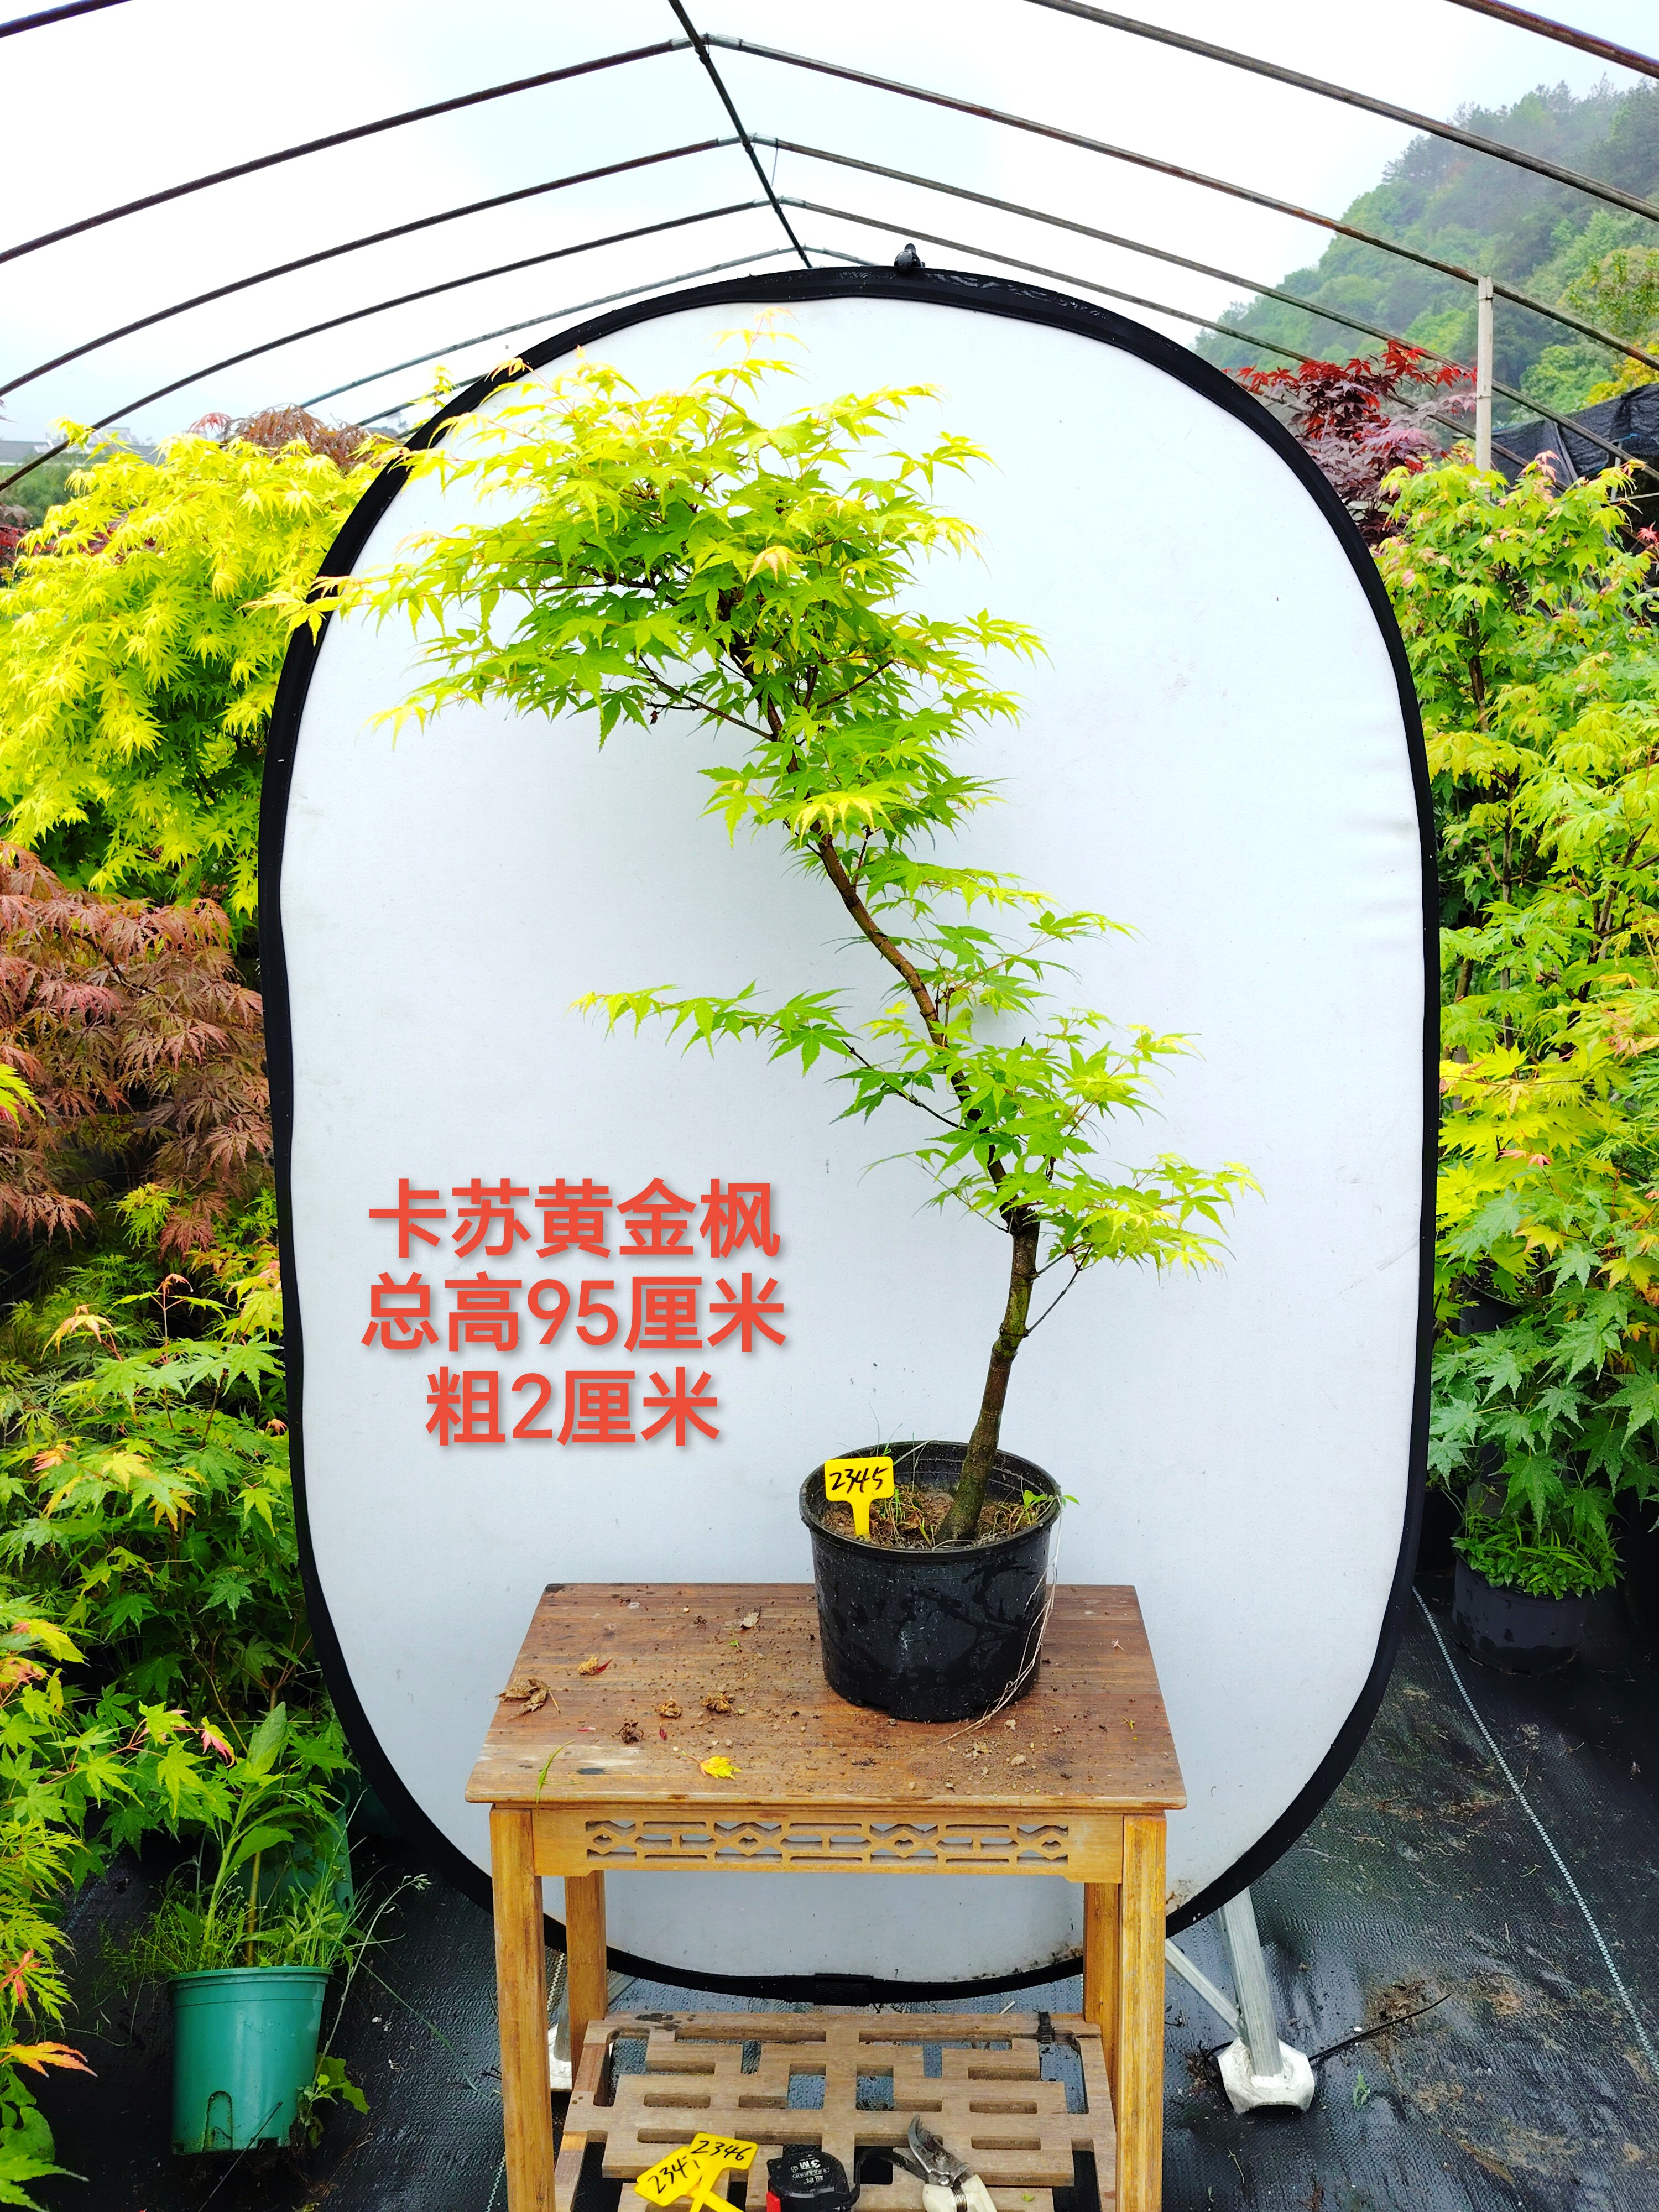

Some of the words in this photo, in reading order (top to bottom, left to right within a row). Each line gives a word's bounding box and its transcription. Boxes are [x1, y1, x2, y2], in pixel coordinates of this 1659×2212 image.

[829, 1467, 889, 1494] 2345
[690, 2140, 753, 2161] 2346
[799, 2159, 821, 2170] 3M
